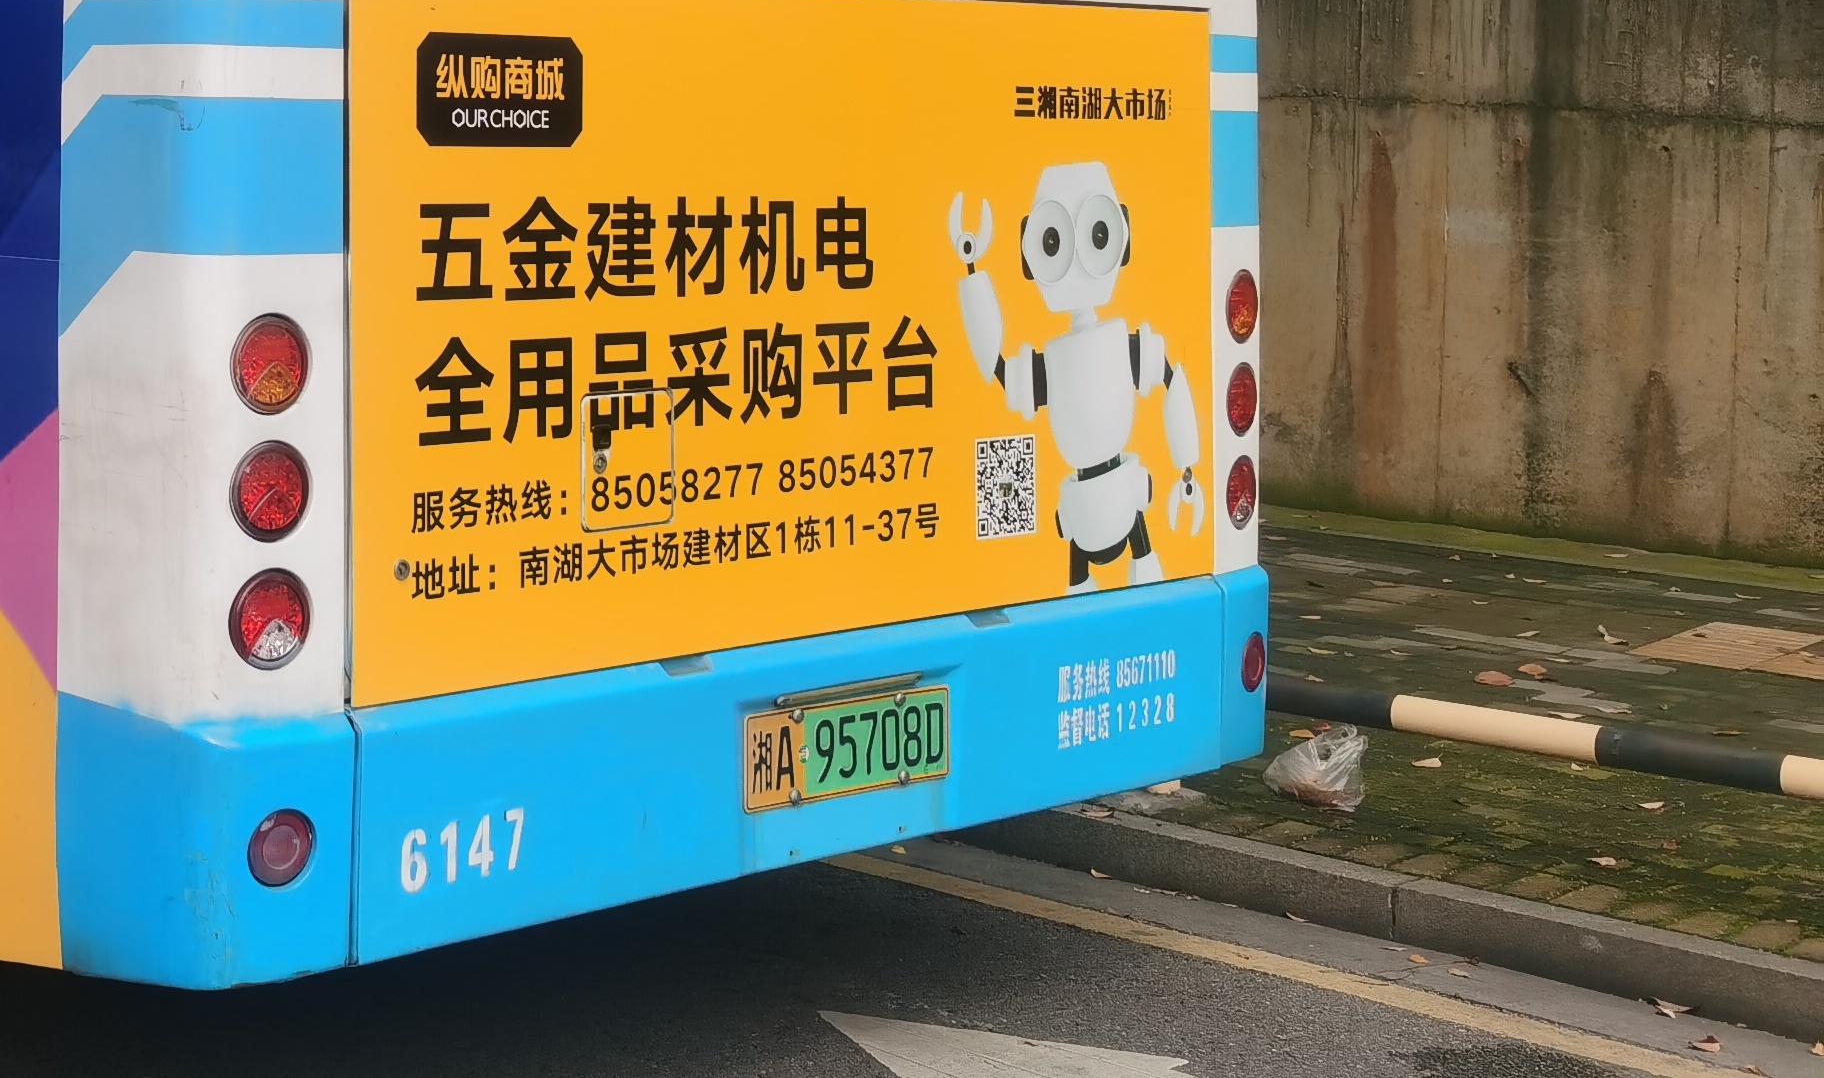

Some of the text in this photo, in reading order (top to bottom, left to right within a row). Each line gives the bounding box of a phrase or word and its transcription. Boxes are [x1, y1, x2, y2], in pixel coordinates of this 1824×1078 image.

[436, 53, 565, 101] 纵购商城
[1014, 85, 1166, 121] 三湘南湖大市场
[415, 195, 875, 303] 五金建材机电
[415, 316, 939, 448] 全用品采购平台
[591, 462, 764, 514] 85058277
[778, 447, 935, 494] 85054377
[519, 503, 940, 588] 南湖大市场建材区1栋11-37号
[1116, 649, 1176, 688] 85671110
[1116, 692, 1175, 733] 12328
[401, 807, 525, 893] 6147
